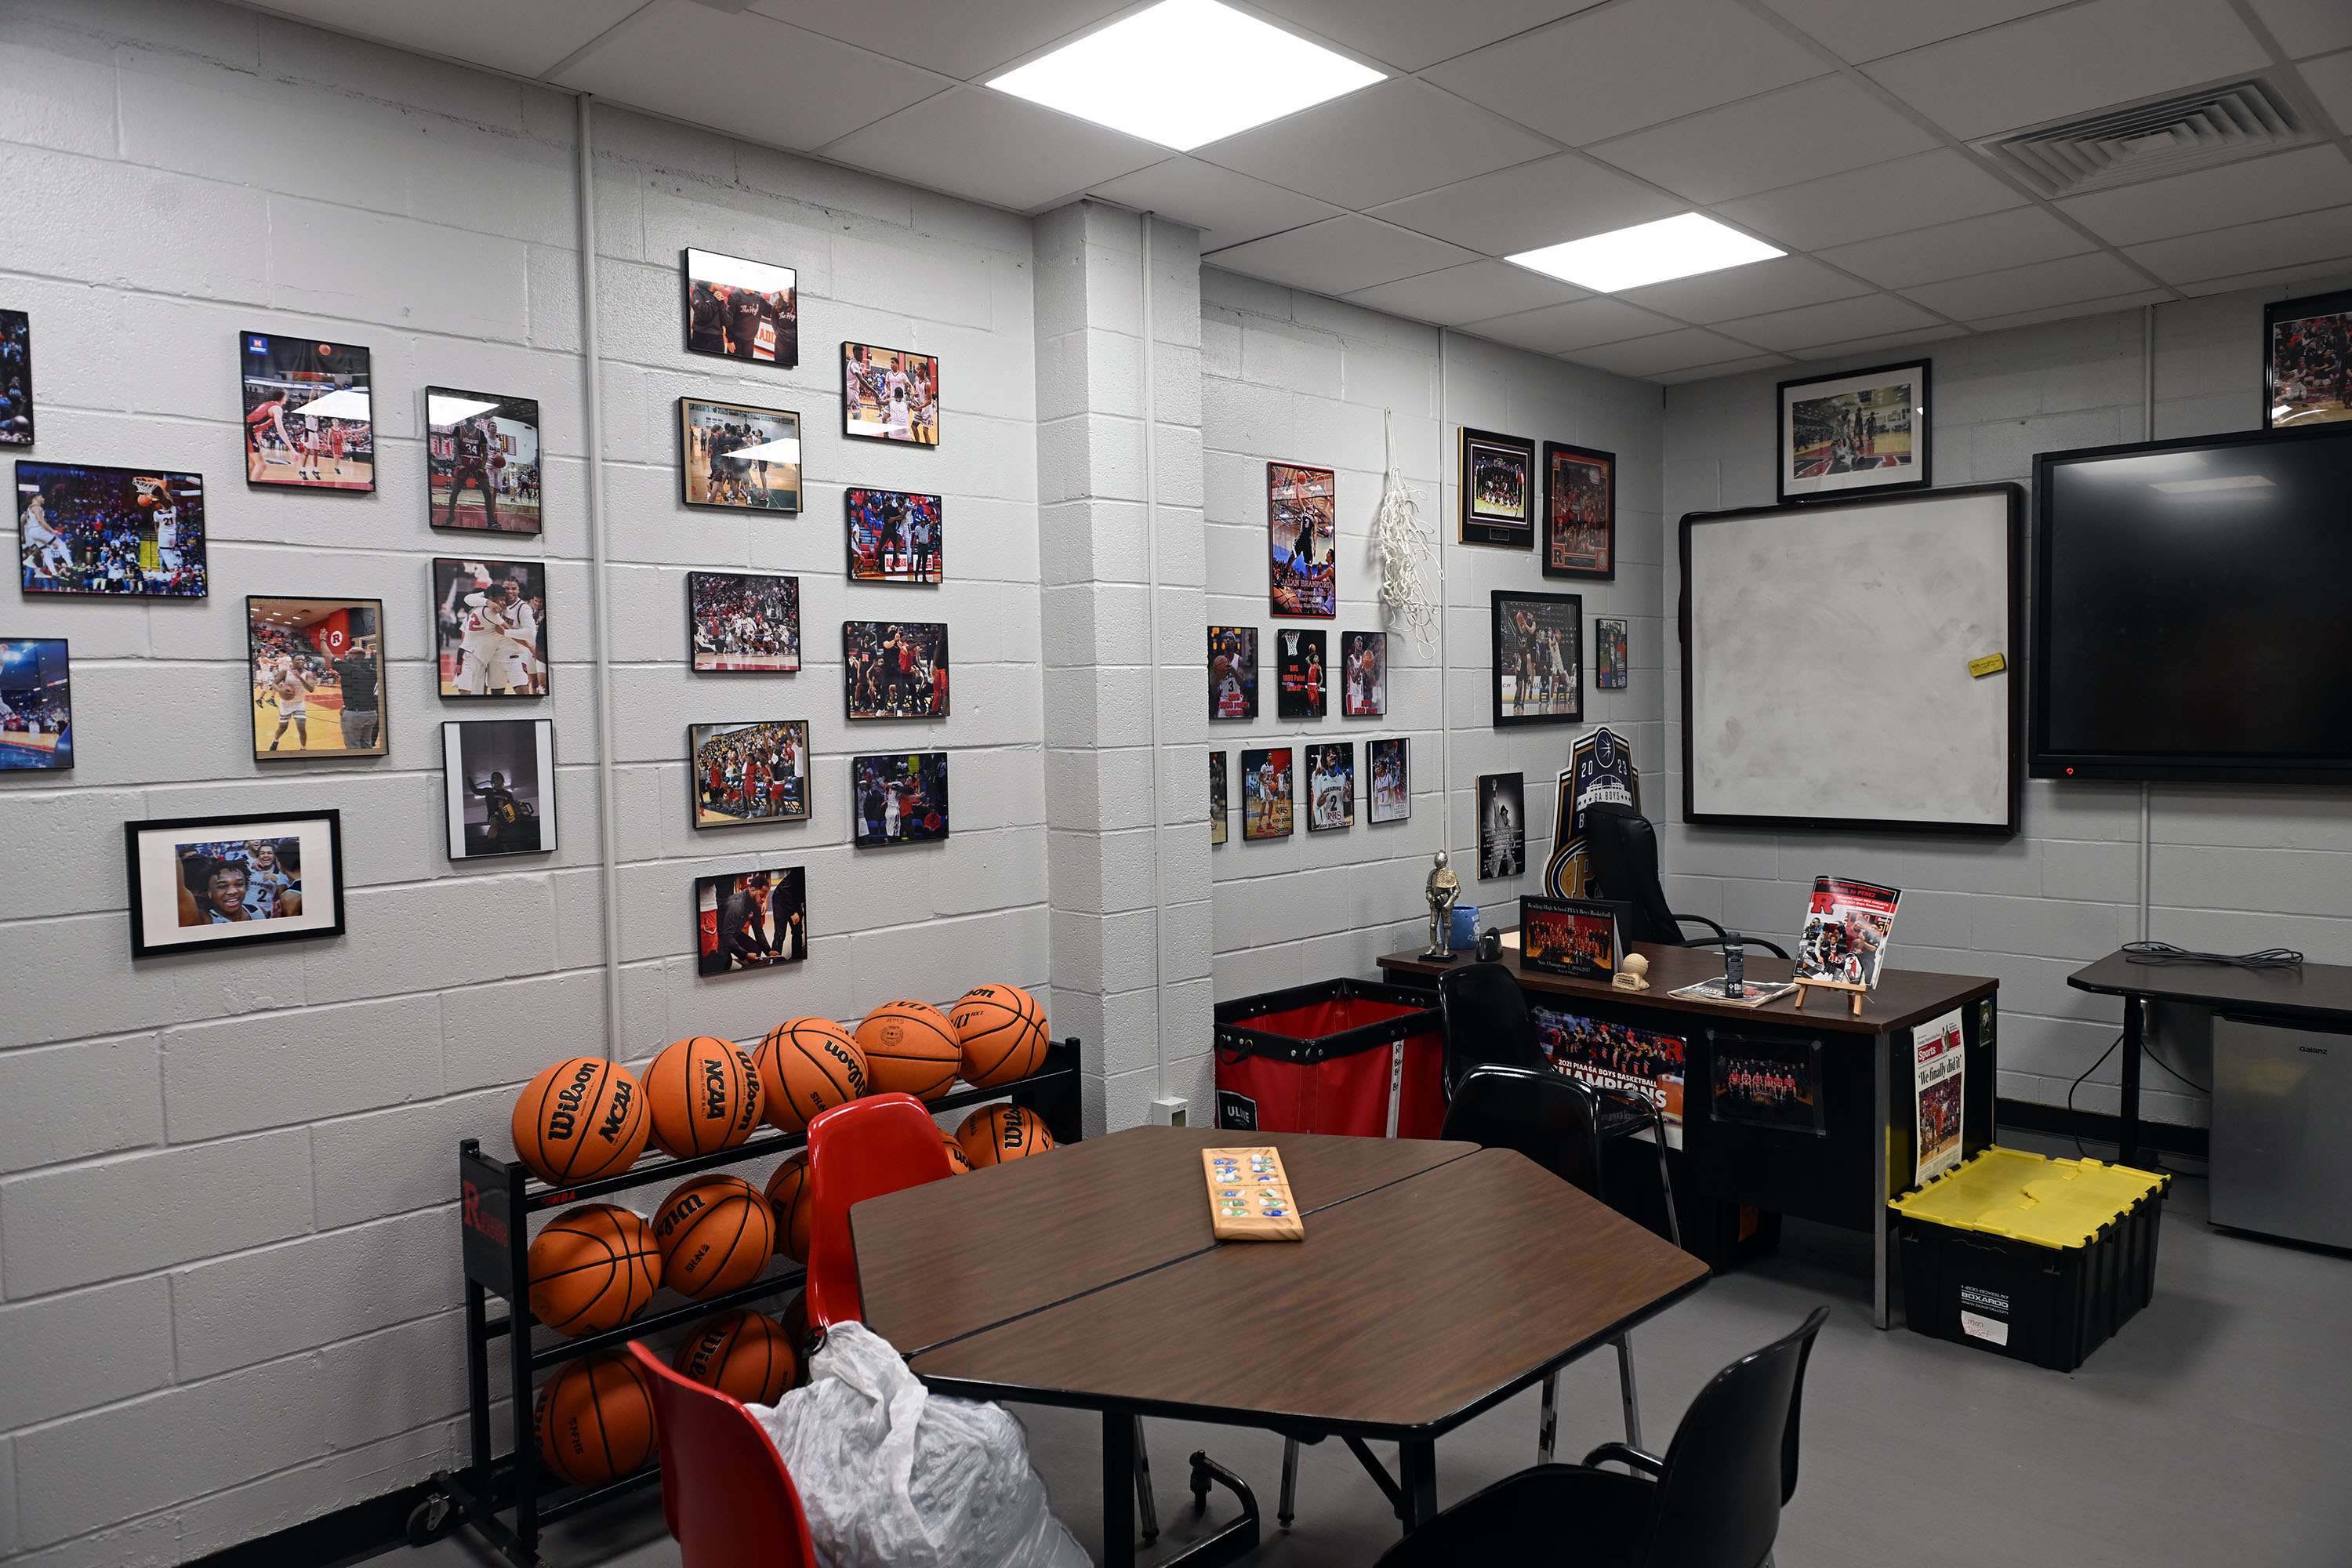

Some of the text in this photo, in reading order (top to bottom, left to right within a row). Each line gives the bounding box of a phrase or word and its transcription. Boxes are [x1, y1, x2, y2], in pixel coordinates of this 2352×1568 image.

[469, 613, 484, 631] 2
[332, 633, 341, 644] R
[1581, 759, 1628, 779] 20 23
[1330, 795, 1338, 811] 2
[1594, 791, 1621, 802] 6A BOYS
[256, 889, 267, 902] 2
[1811, 895, 1834, 914] R
[1918, 1047, 1936, 1062] Sports
[2299, 1046, 2328, 1055] Galanz
[1558, 1058, 1658, 1088] 2021 PIAA 6A BOYS BASKETBALL
[1929, 1062, 1946, 1082] finally
[1947, 1058, 1956, 1073] did
[704, 1059, 727, 1120] NCAA
[735, 1051, 760, 1131] Wilson
[548, 1062, 600, 1141] Wilson
[598, 1080, 633, 1144] NCAA
[1004, 1104, 1024, 1150] Wils
[550, 1191, 576, 1205] KBA
[656, 1194, 706, 1236] Wils
[1961, 1291, 2009, 1308] BOXAROO
